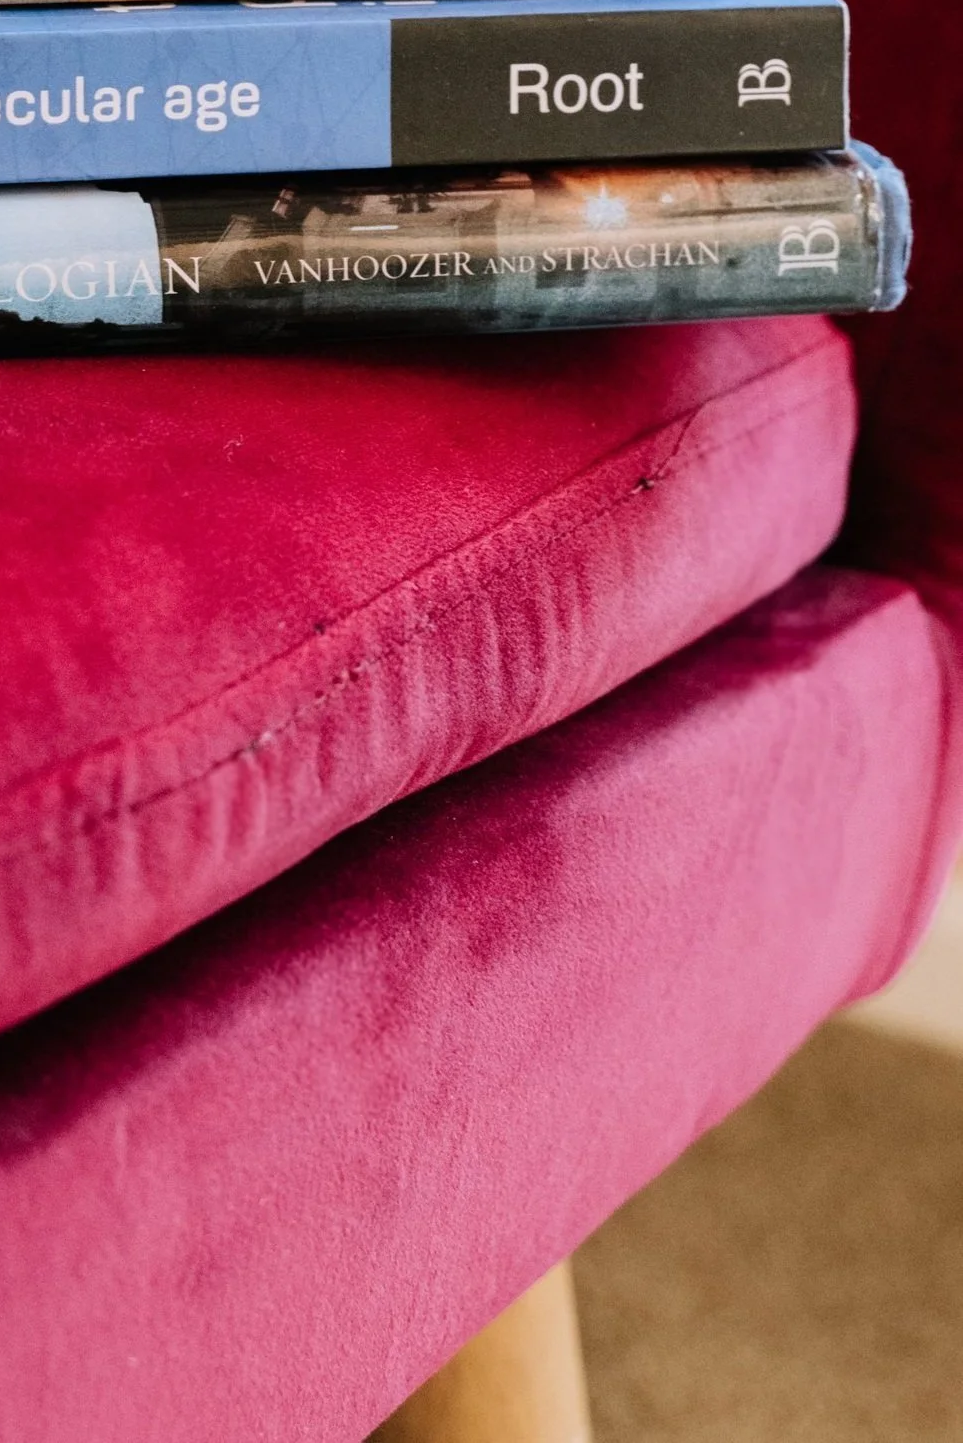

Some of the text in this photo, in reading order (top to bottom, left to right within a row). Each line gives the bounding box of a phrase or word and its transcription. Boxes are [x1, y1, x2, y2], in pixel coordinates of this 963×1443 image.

[164, 80, 261, 132] age
[509, 62, 645, 115] Root
[253, 240, 721, 286] VANHOOZER AND STRACHAN
